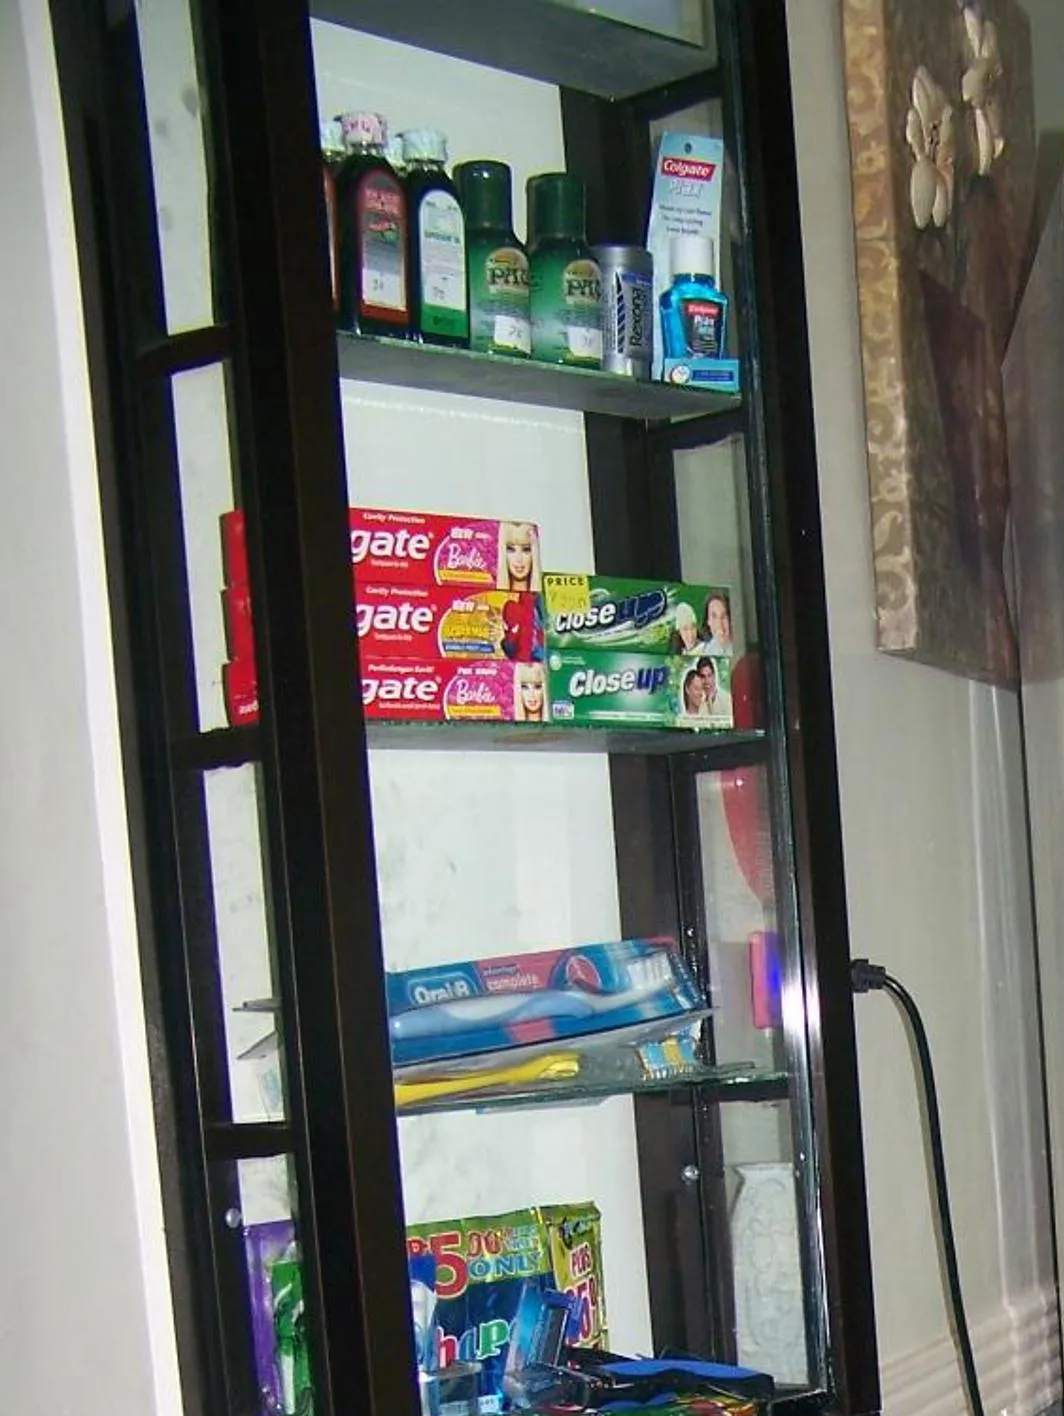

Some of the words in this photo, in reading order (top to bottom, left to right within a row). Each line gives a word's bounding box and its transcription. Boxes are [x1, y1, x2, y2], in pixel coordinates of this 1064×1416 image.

[663, 160, 710, 177] Colgate
[629, 286, 645, 347] Rexona
[350, 529, 431, 563] gate
[546, 576, 585, 587] PRICE
[356, 602, 434, 637] gate
[361, 676, 439, 705] gate
[468, 1251, 543, 1280] ONLY
